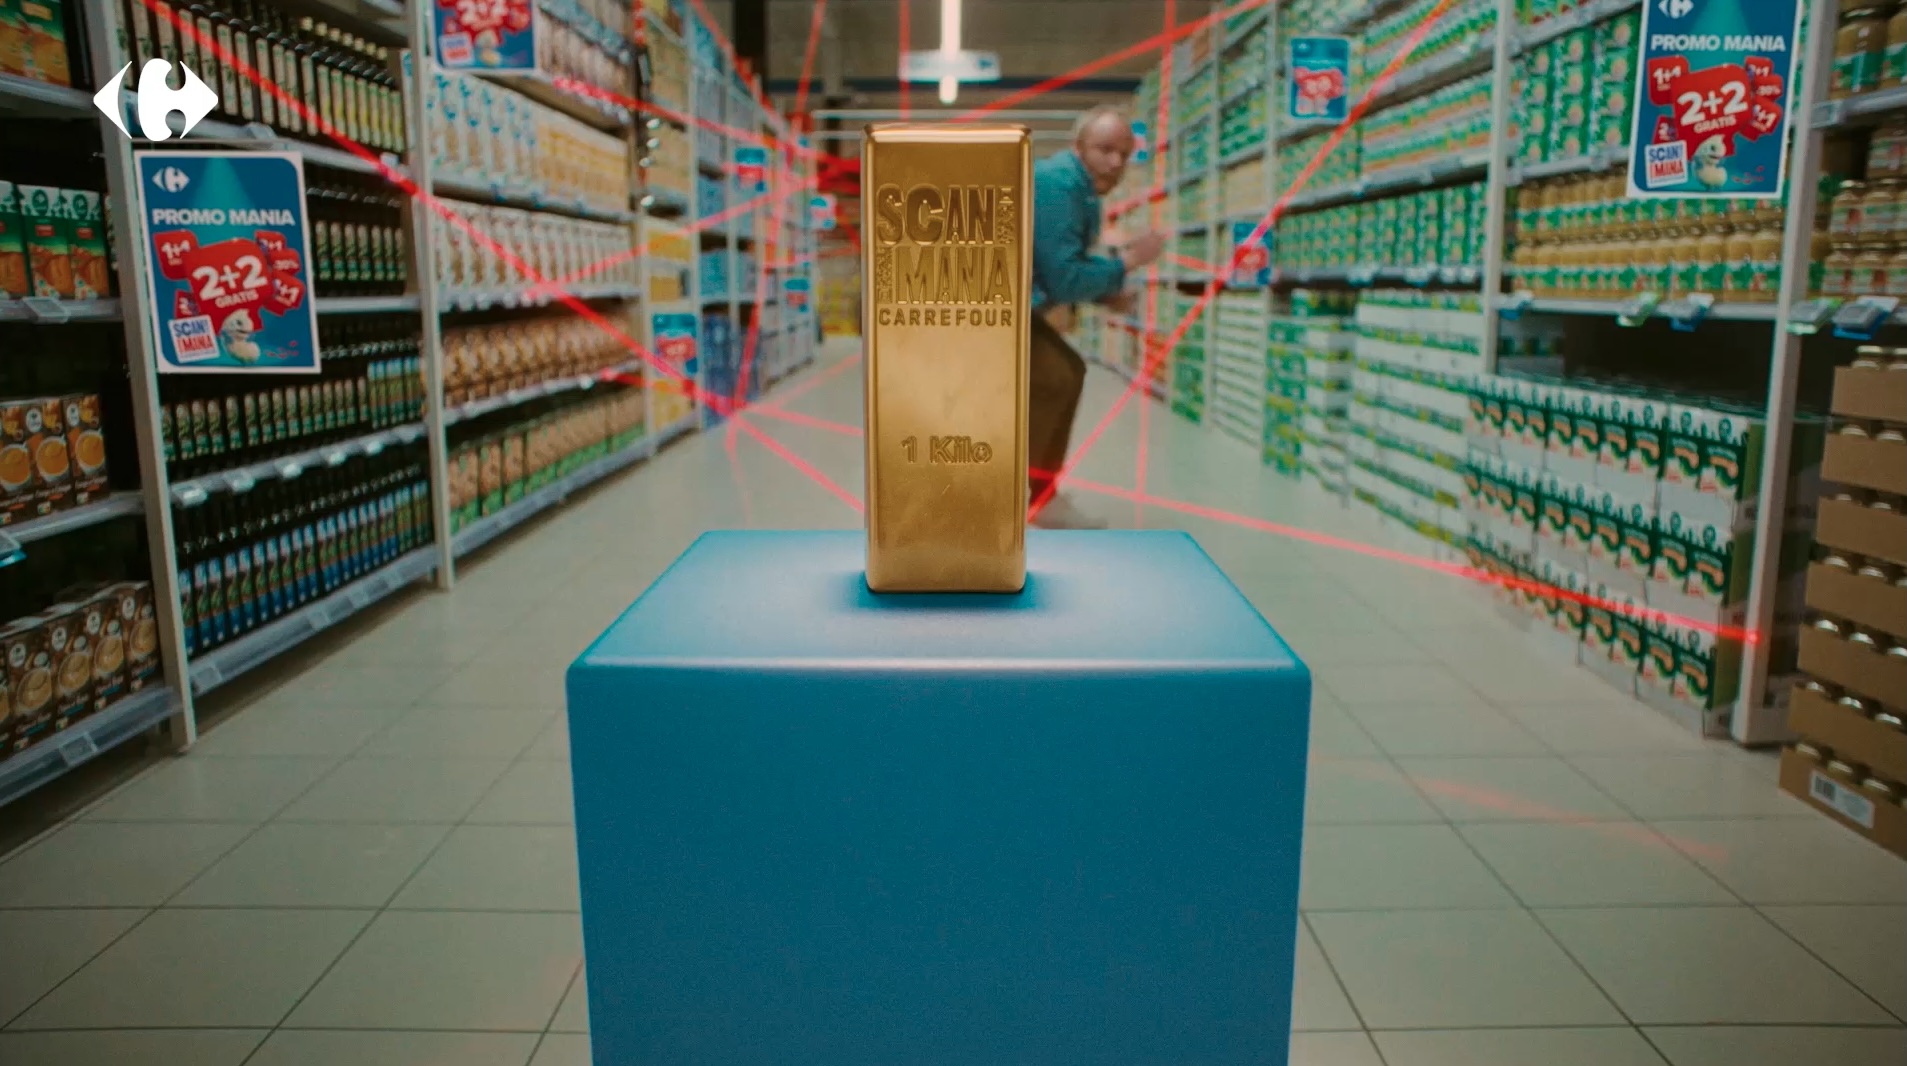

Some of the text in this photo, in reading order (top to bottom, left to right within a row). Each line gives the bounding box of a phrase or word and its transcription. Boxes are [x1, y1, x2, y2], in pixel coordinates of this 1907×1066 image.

[1650, 34, 1786, 51] PROMO MANIA
[1677, 81, 1748, 126] 2+2
[1693, 114, 1737, 134] GRATIS
[152, 208, 296, 226] PROMO MANIA
[877, 184, 995, 245] SCAN
[192, 255, 268, 300] 2+2
[215, 290, 259, 308] GRATIS
[878, 307, 1013, 326] CARREFOUR
[901, 435, 993, 464] 1 Kilo
